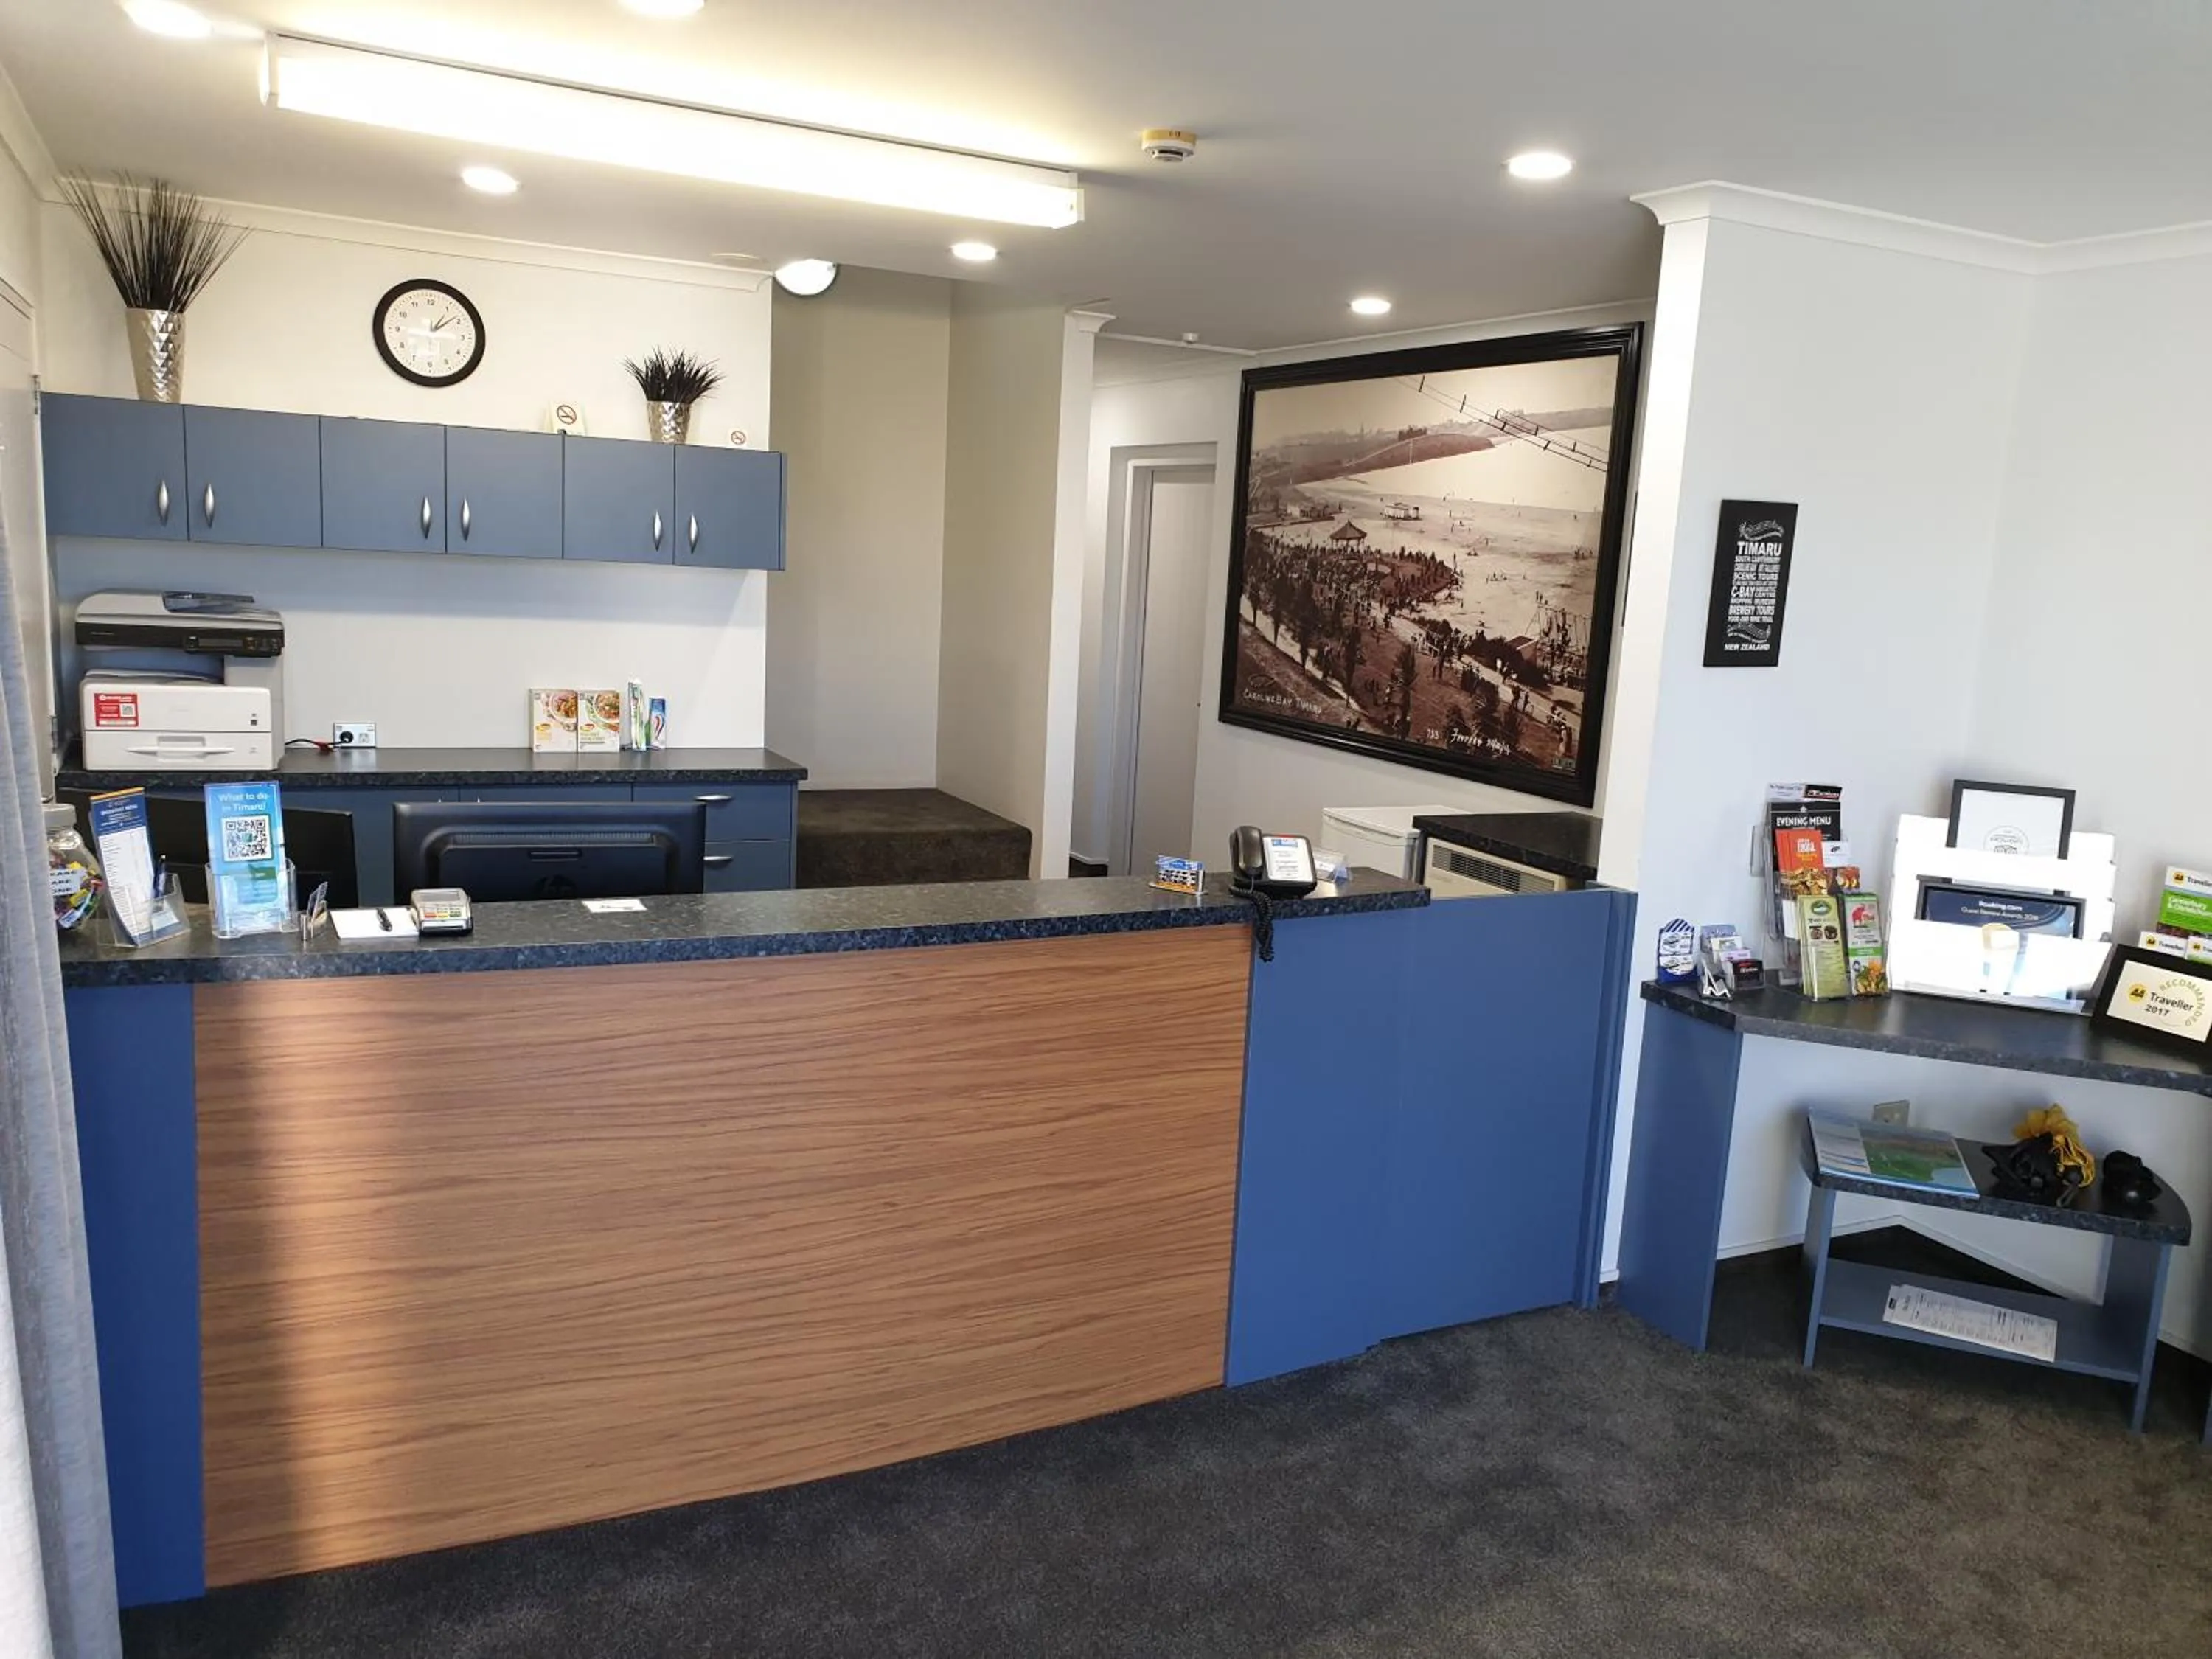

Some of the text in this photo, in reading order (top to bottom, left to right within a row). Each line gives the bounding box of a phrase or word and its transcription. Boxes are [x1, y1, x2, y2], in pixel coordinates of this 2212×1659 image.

[1736, 540, 1783, 556] TIMARU
[220, 793, 243, 801] What
[256, 792, 268, 801] do
[1776, 815, 1832, 827] EVENING MENU
[1978, 900, 2023, 911] Booking.com
[2150, 992, 2195, 1011] Traveller
[2159, 979, 2205, 1027] RECOMMENDED
[2144, 1004, 2170, 1016] 2017
